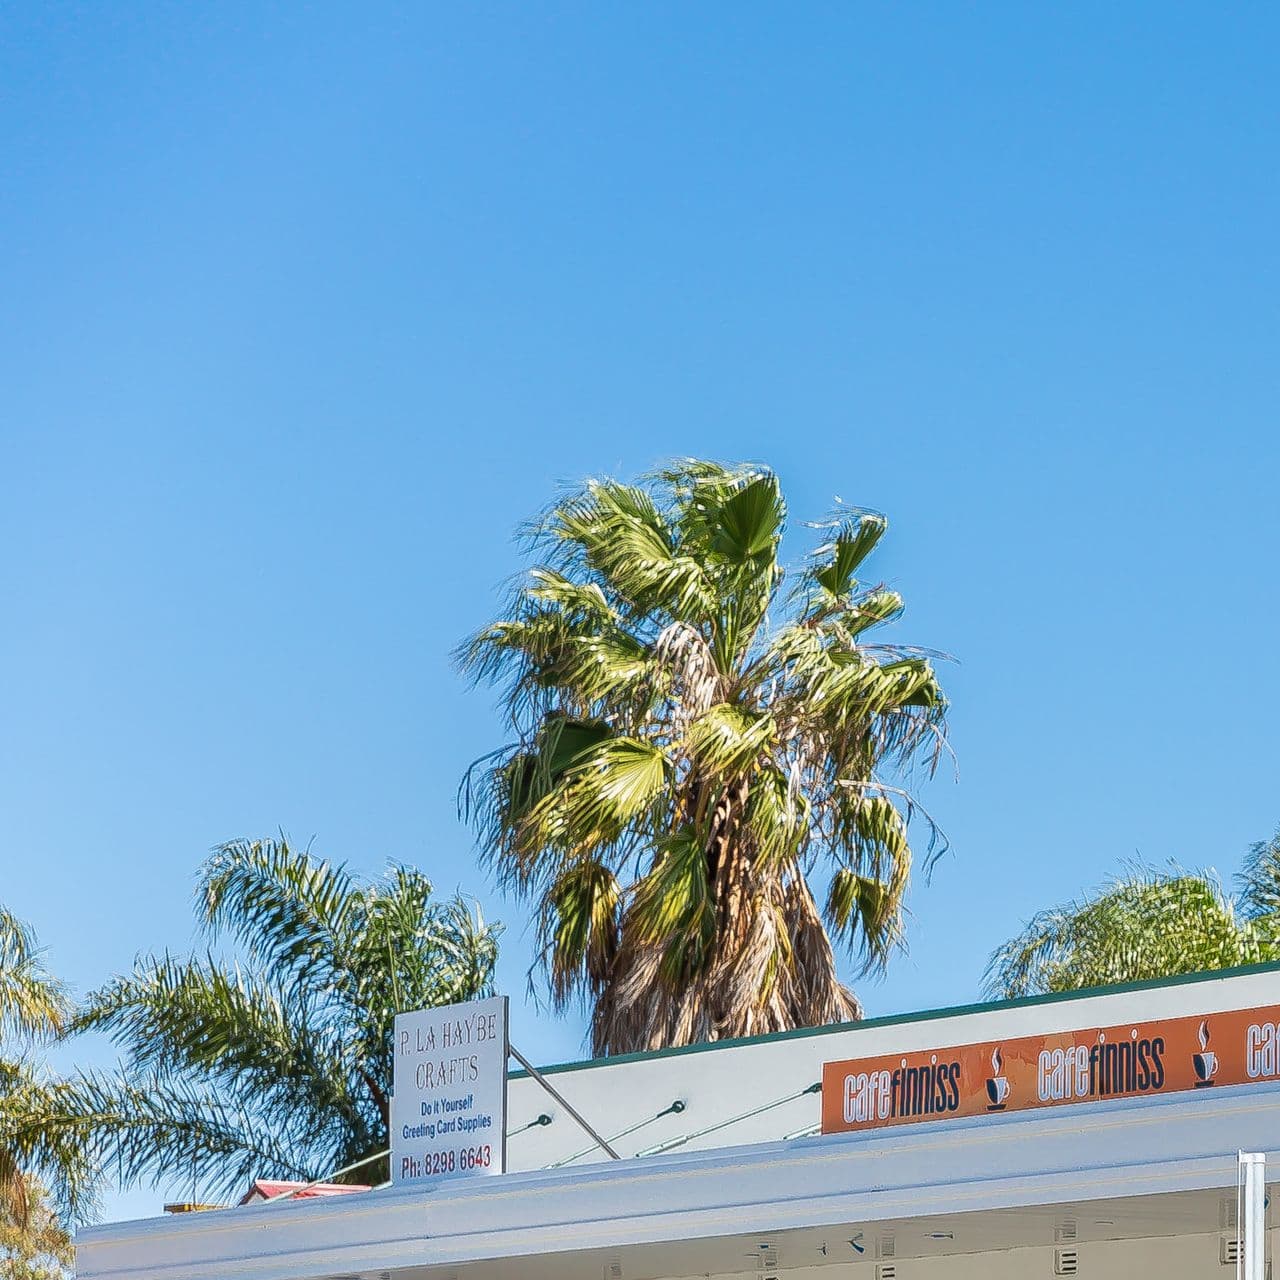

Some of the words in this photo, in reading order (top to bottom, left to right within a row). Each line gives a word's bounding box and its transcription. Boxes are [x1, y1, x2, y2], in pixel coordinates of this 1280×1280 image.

[416, 1026, 435, 1052] LA
[416, 1055, 479, 1090] CRAFTS
[421, 1101, 432, 1117] Do
[441, 1094, 474, 1113] Yourself
[402, 1122, 436, 1139] Greeting
[437, 1117, 456, 1134] Card
[457, 1114, 491, 1133] Supplies
[402, 1156, 421, 1179] Ph:
[425, 1150, 455, 1175] 8298
[460, 1145, 491, 1170] 6643
